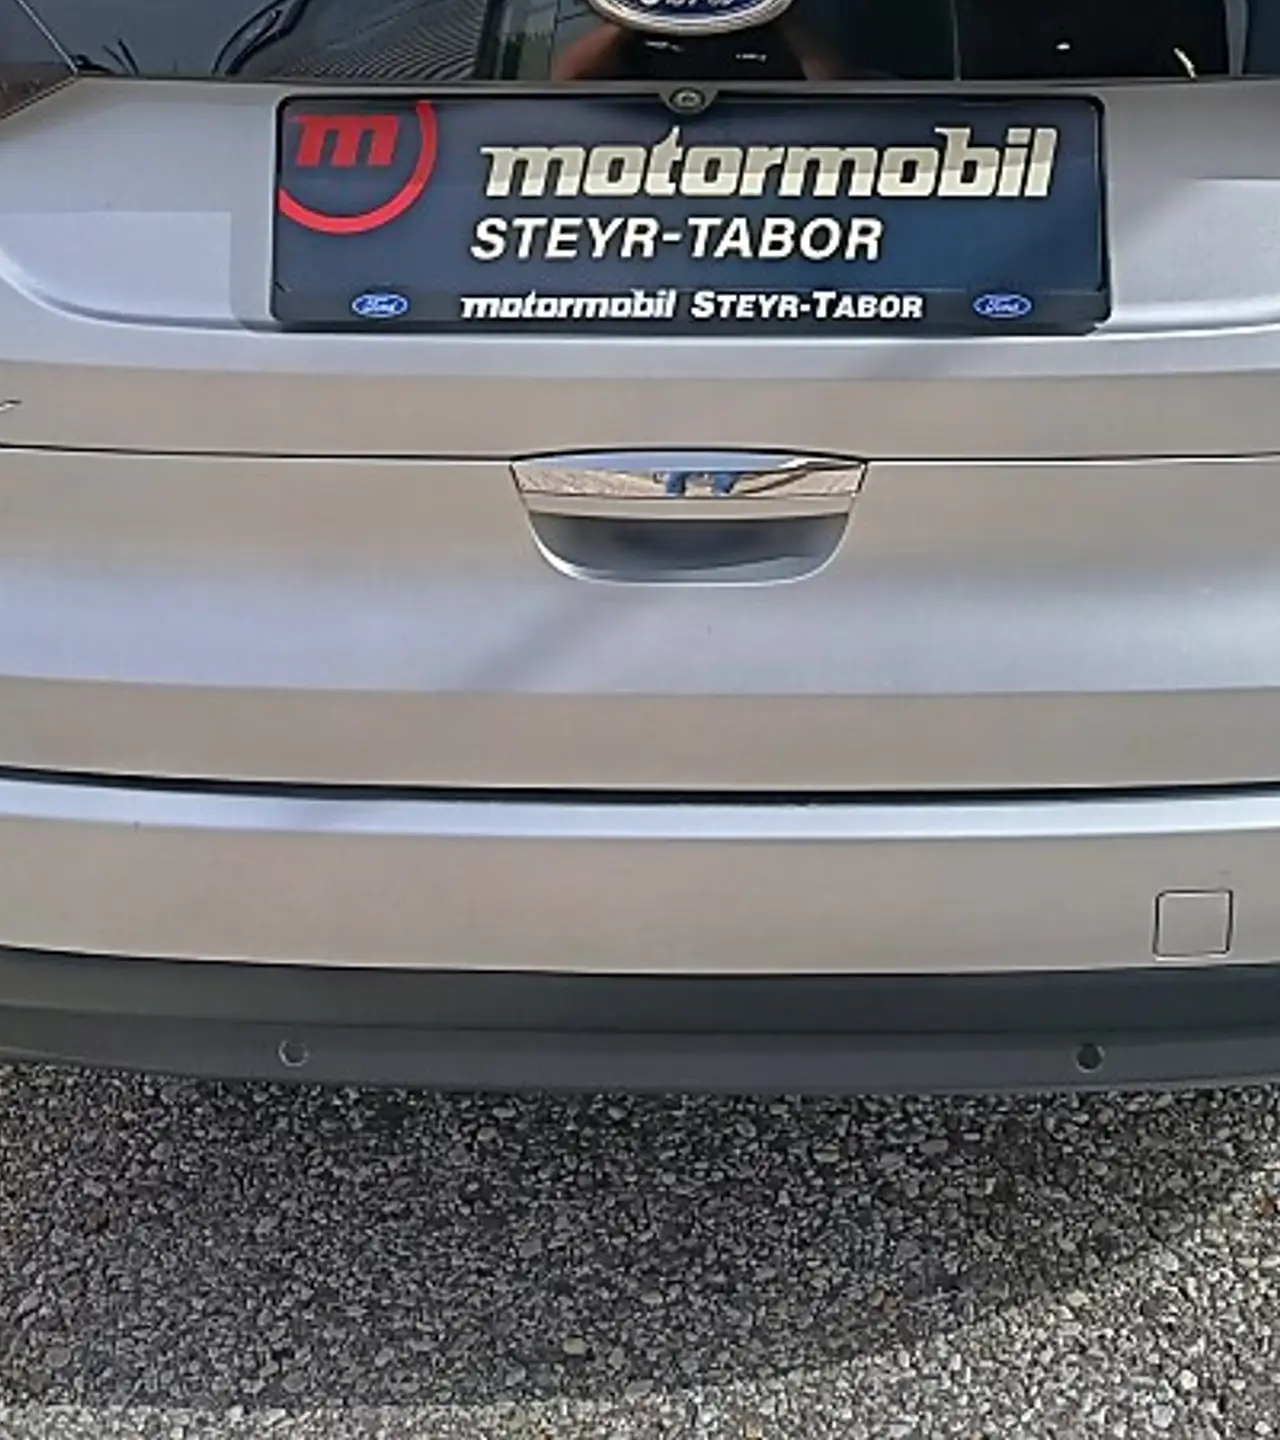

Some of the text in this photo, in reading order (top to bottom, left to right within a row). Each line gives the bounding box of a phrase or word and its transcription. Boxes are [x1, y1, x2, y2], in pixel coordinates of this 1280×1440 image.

[290, 114, 400, 167] m
[480, 126, 1058, 198] motormobil
[469, 216, 885, 262] STEYR-TABOR
[460, 290, 924, 320] motormobil STEYR-TABOR
